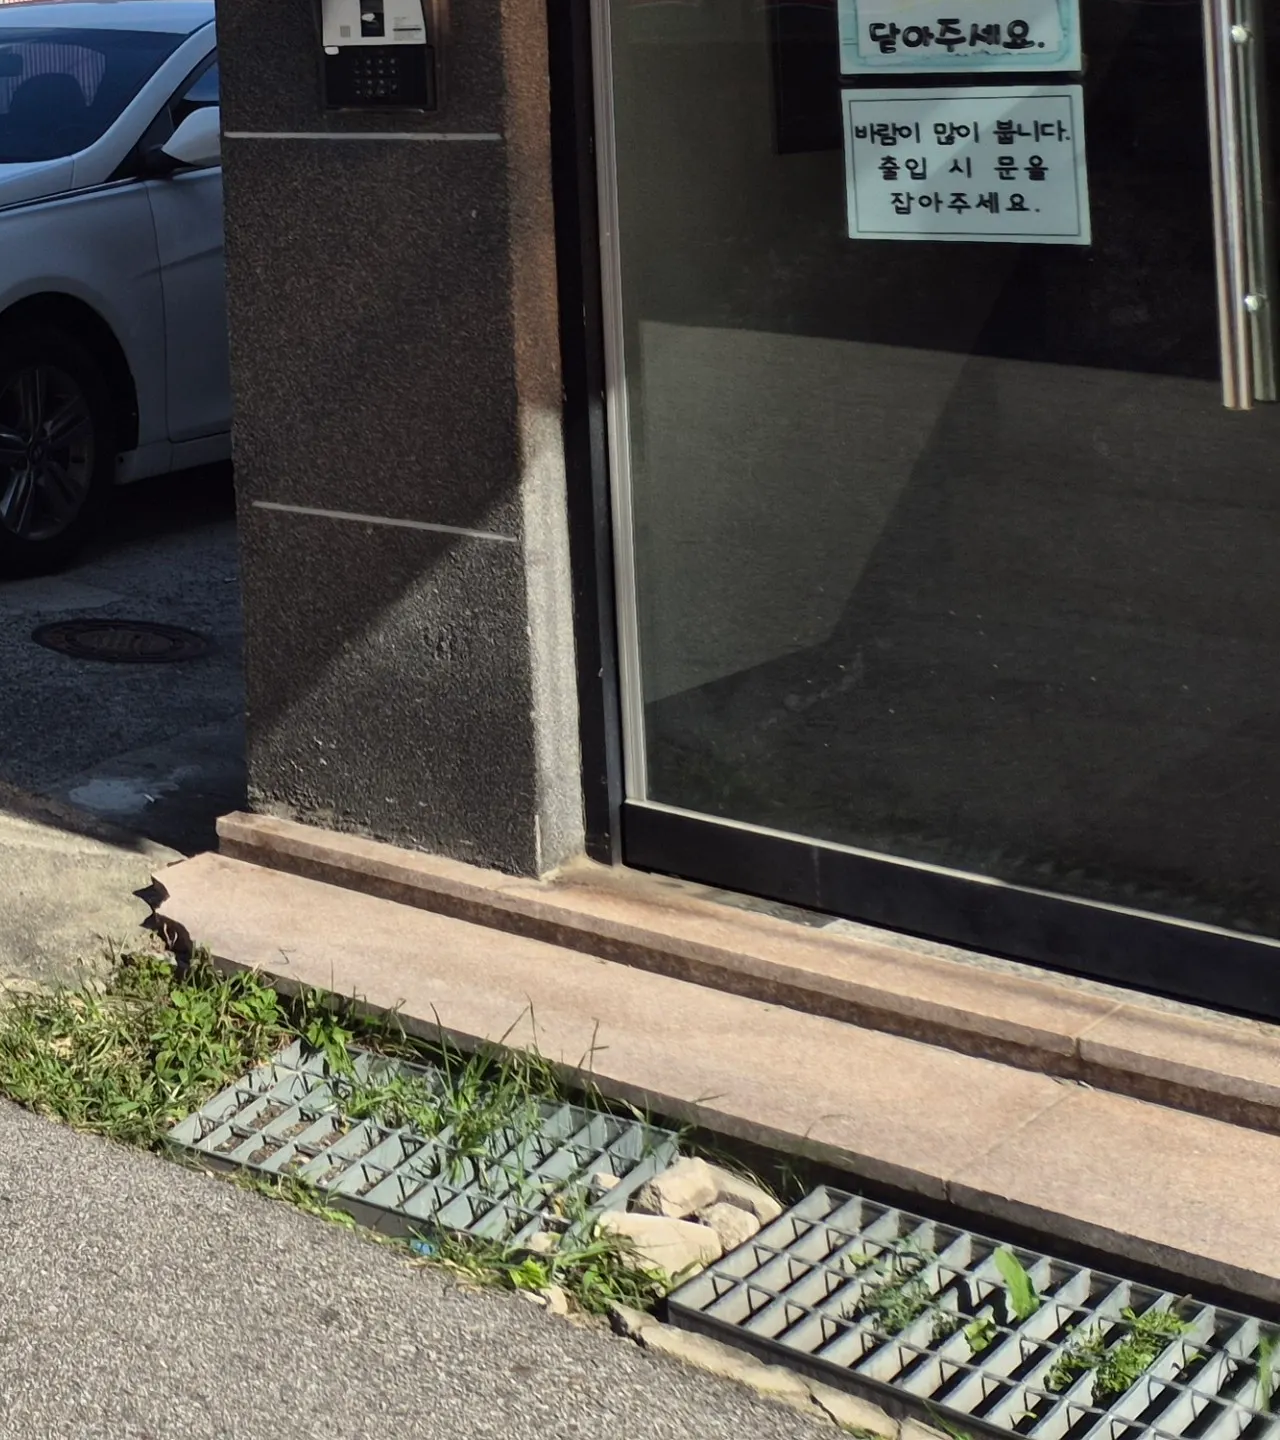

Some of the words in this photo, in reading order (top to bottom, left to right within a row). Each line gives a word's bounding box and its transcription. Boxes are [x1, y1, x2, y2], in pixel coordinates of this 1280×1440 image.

[868, 19, 1046, 54] 닫아주세요.
[855, 122, 921, 147] 바람이
[933, 121, 980, 146] 많이
[877, 155, 928, 181] 출입
[948, 156, 972, 178] 시
[993, 155, 1050, 181] 문을
[889, 191, 1041, 216] 잡아주세요.
